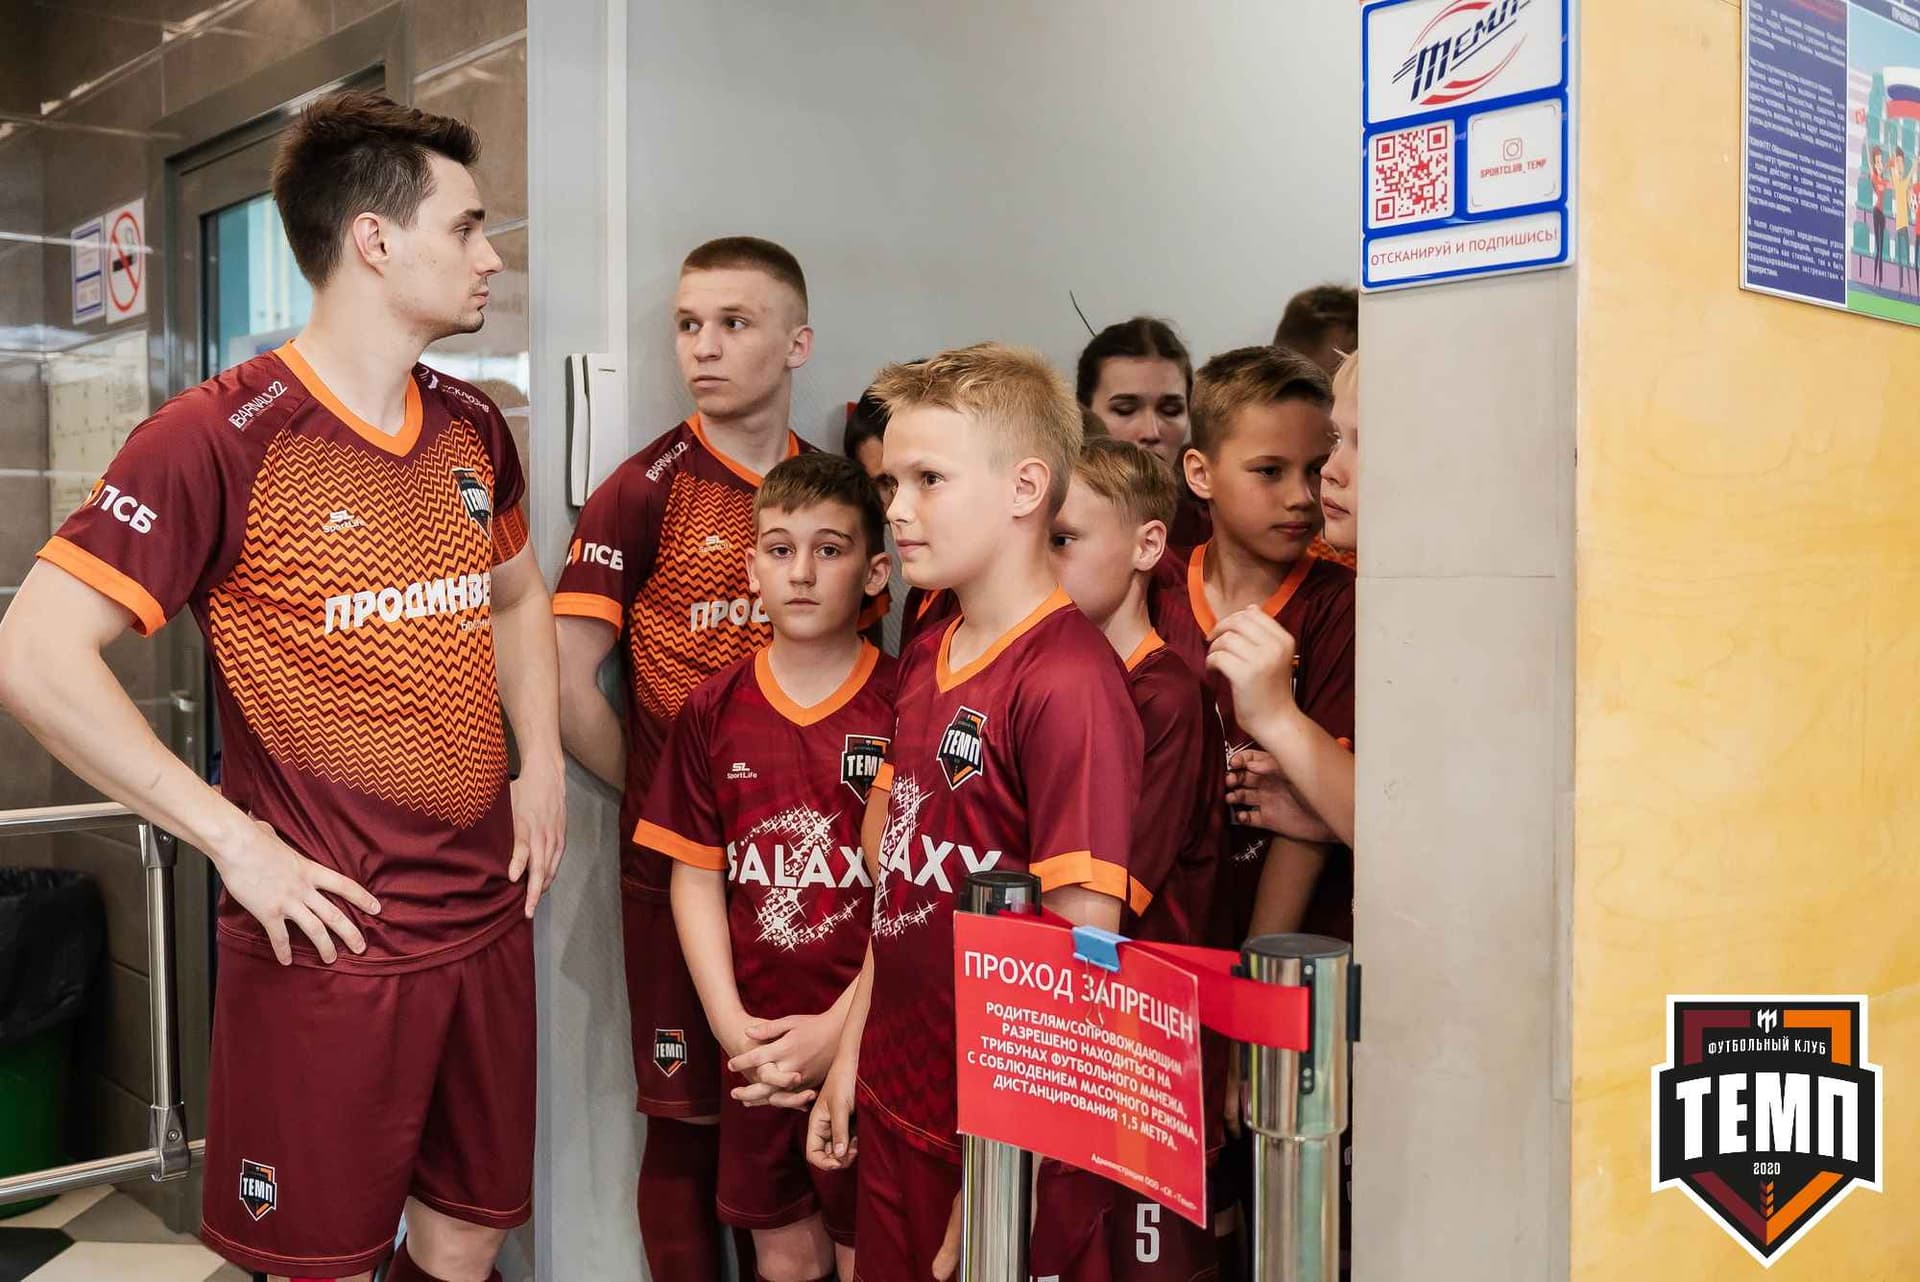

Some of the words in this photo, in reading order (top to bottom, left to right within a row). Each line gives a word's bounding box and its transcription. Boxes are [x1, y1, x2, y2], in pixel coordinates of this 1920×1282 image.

[1371, 241, 1451, 266] ОТСКАНИРУЙ
[1456, 243, 1464, 254] И
[1469, 229, 1557, 252] ПОДПИШИСЬ!
[93, 484, 158, 534] ПСБ
[583, 543, 623, 571] ПСБ
[847, 755, 884, 776] ТЕМ
[943, 729, 980, 766] ТЕМП
[727, 841, 873, 888] ALAX
[880, 827, 1002, 893] AXY
[964, 950, 1073, 1004] ПРОХОД
[1081, 973, 1194, 1044] ЗАПРЕЩЕН
[986, 1002, 1182, 1075] РОДИТЕЛЯМ/СОПРОВОЖДАЮЩИМ
[1002, 1023, 1077, 1052] РАЗРЕШЕНО
[1081, 1043, 1155, 1080] НАХОДИТЬСЯ
[1158, 1072, 1172, 1089] НА
[967, 1051, 975, 1064] С
[979, 1053, 1077, 1089] СОБЛЮДЕНИЕМ
[1080, 1081, 1149, 1115] МАСОЧНОГО
[1151, 1109, 1198, 1144] РЕЖИМА,
[981, 1036, 1048, 1062] ТРИБУНАХ
[1051, 1052, 1138, 1093] ФУТБОЛЬНОГО
[1140, 1086, 1187, 1118] МАНЕЖА,
[993, 1074, 1118, 1121] ДИСТАНЦИРОВАНИЯ
[1122, 1113, 1138, 1130] 1,5
[1140, 1123, 1178, 1150] МЕТРА.
[243, 1177, 273, 1203] ТЕМП
[1136, 1203, 1160, 1263] 5
